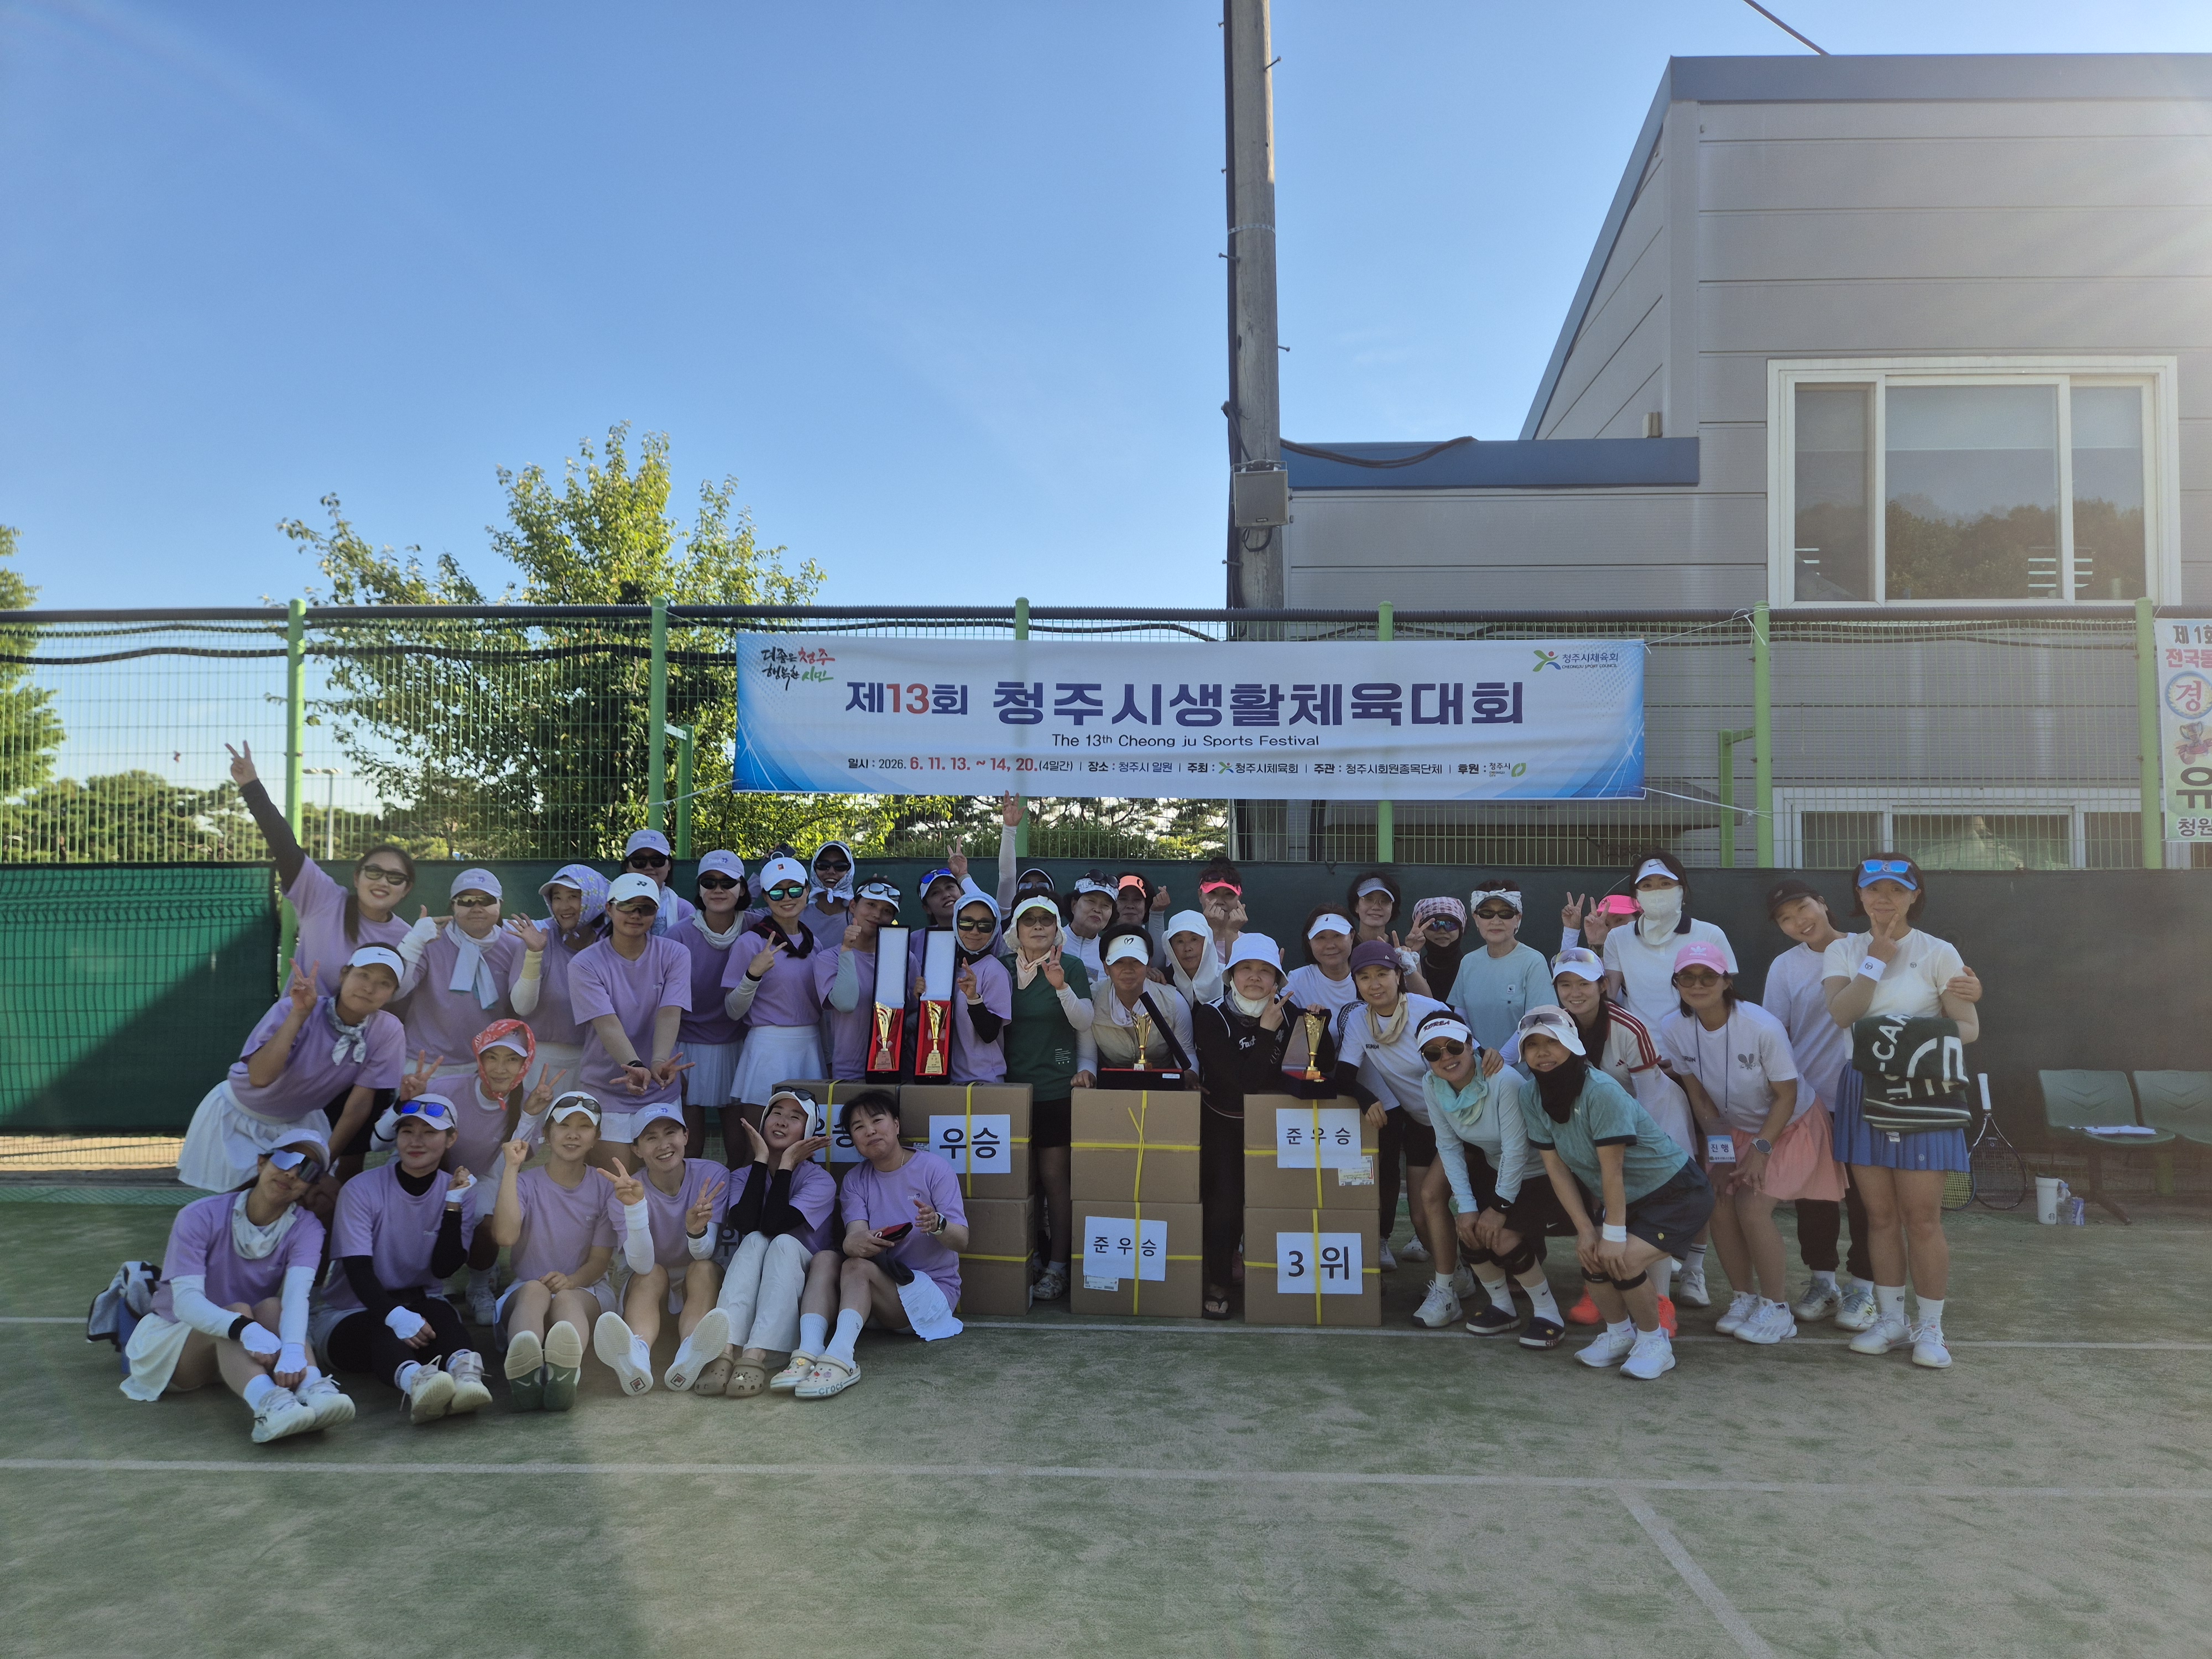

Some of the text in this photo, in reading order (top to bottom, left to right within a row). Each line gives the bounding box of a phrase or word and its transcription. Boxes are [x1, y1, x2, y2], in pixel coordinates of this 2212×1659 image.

[2173, 625, 2189, 644] 제
[798, 646, 836, 665] 청주
[1562, 653, 1618, 663] 청주시체육회
[761, 663, 834, 691] 행복한 시민
[846, 681, 1523, 726] 제13회 청주시생활체육대회
[2176, 681, 2201, 712] 경
[1052, 734, 1319, 748] The 13th Cheong ju Sports Festival
[848, 758, 868, 769] 일시
[879, 759, 906, 769] 2026.
[910, 757, 923, 770] 6.
[928, 757, 945, 770] 11.
[951, 757, 970, 770] 13.
[990, 758, 1010, 772] 14,
[1088, 761, 1108, 772] 장소
[1119, 762, 1149, 773] 청주시
[1152, 762, 1172, 773] 일원
[1187, 763, 1208, 773] 주최
[1235, 763, 1298, 774] 청주시체육회
[1314, 764, 1335, 774] 주관
[1346, 764, 1442, 774] 청주시회원종목단체
[1458, 764, 1479, 774] 후원
[1423, 1020, 1450, 1032] KOREA
[940, 1128, 1000, 1159] 우승
[818, 1381, 843, 1395] crocs
